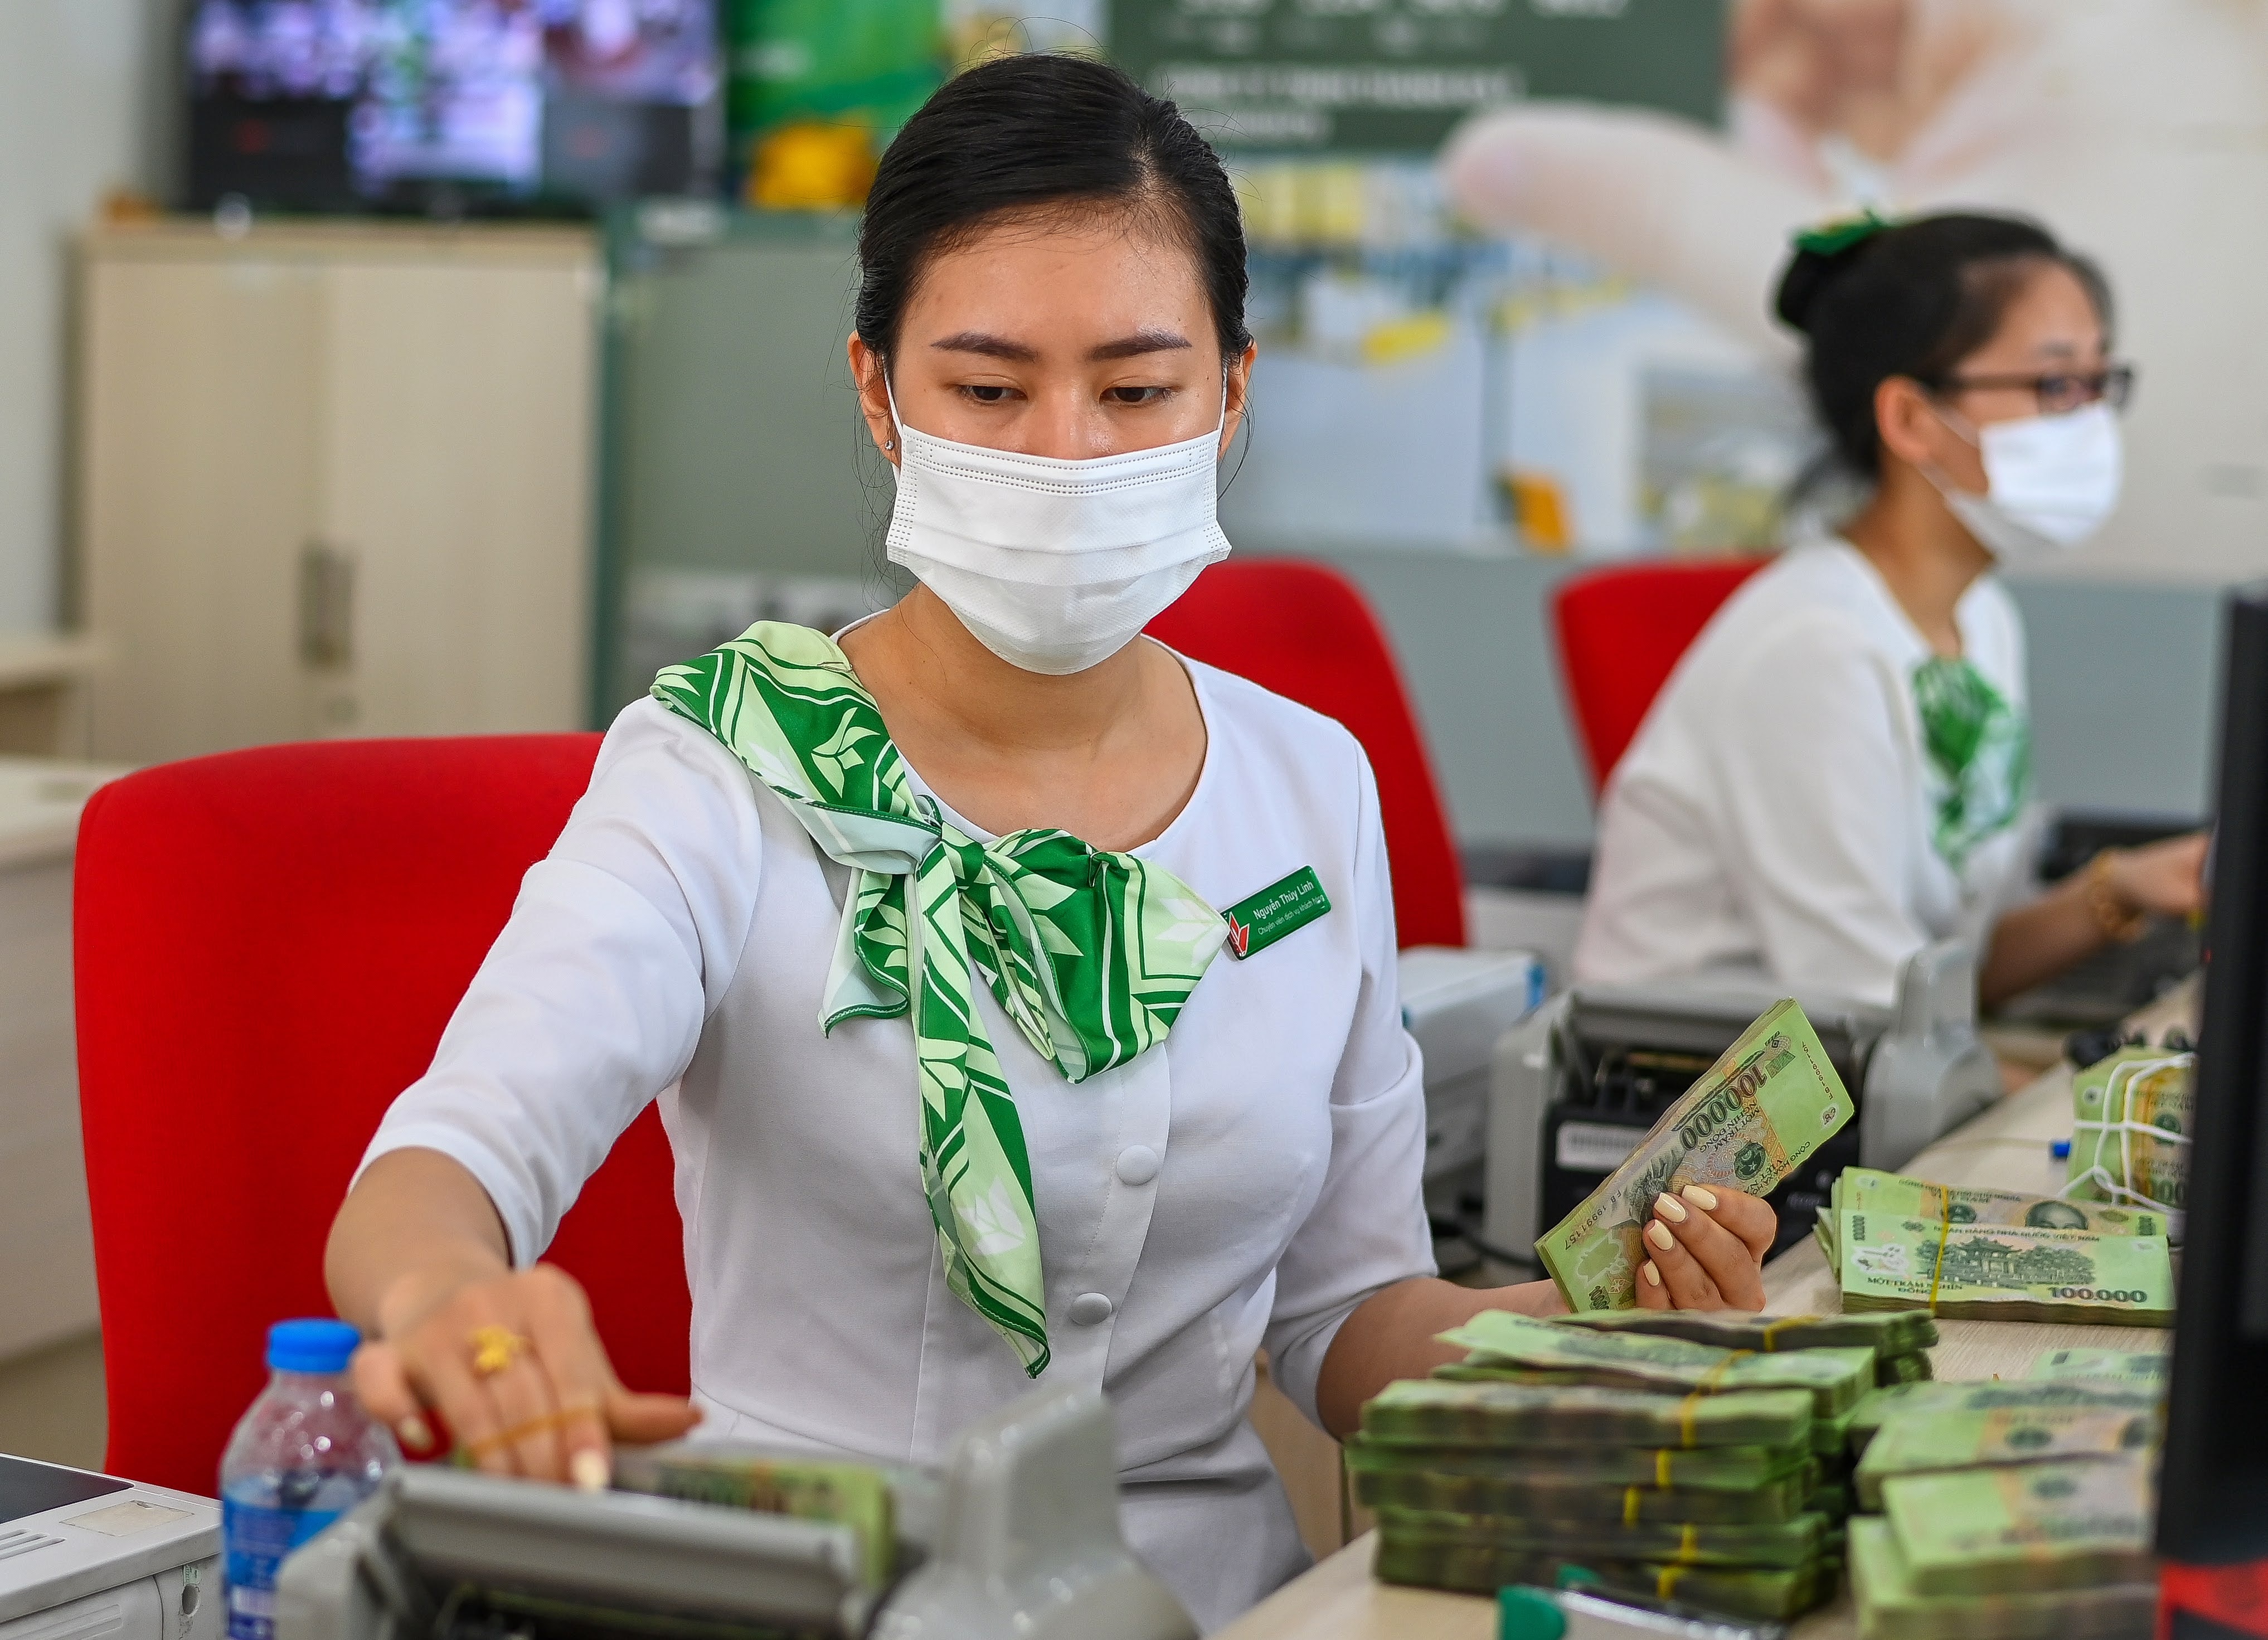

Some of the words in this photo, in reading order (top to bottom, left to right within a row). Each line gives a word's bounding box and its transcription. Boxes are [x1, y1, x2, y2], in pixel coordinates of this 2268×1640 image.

[1278, 890, 1299, 905] Thùy
[1296, 880, 1314, 895] Linh
[1679, 1064, 1768, 1151] 100.000
[1610, 1190, 1622, 1203] FB
[1565, 1205, 1606, 1251] 19991157
[2048, 1287, 2148, 1303] 100.000
